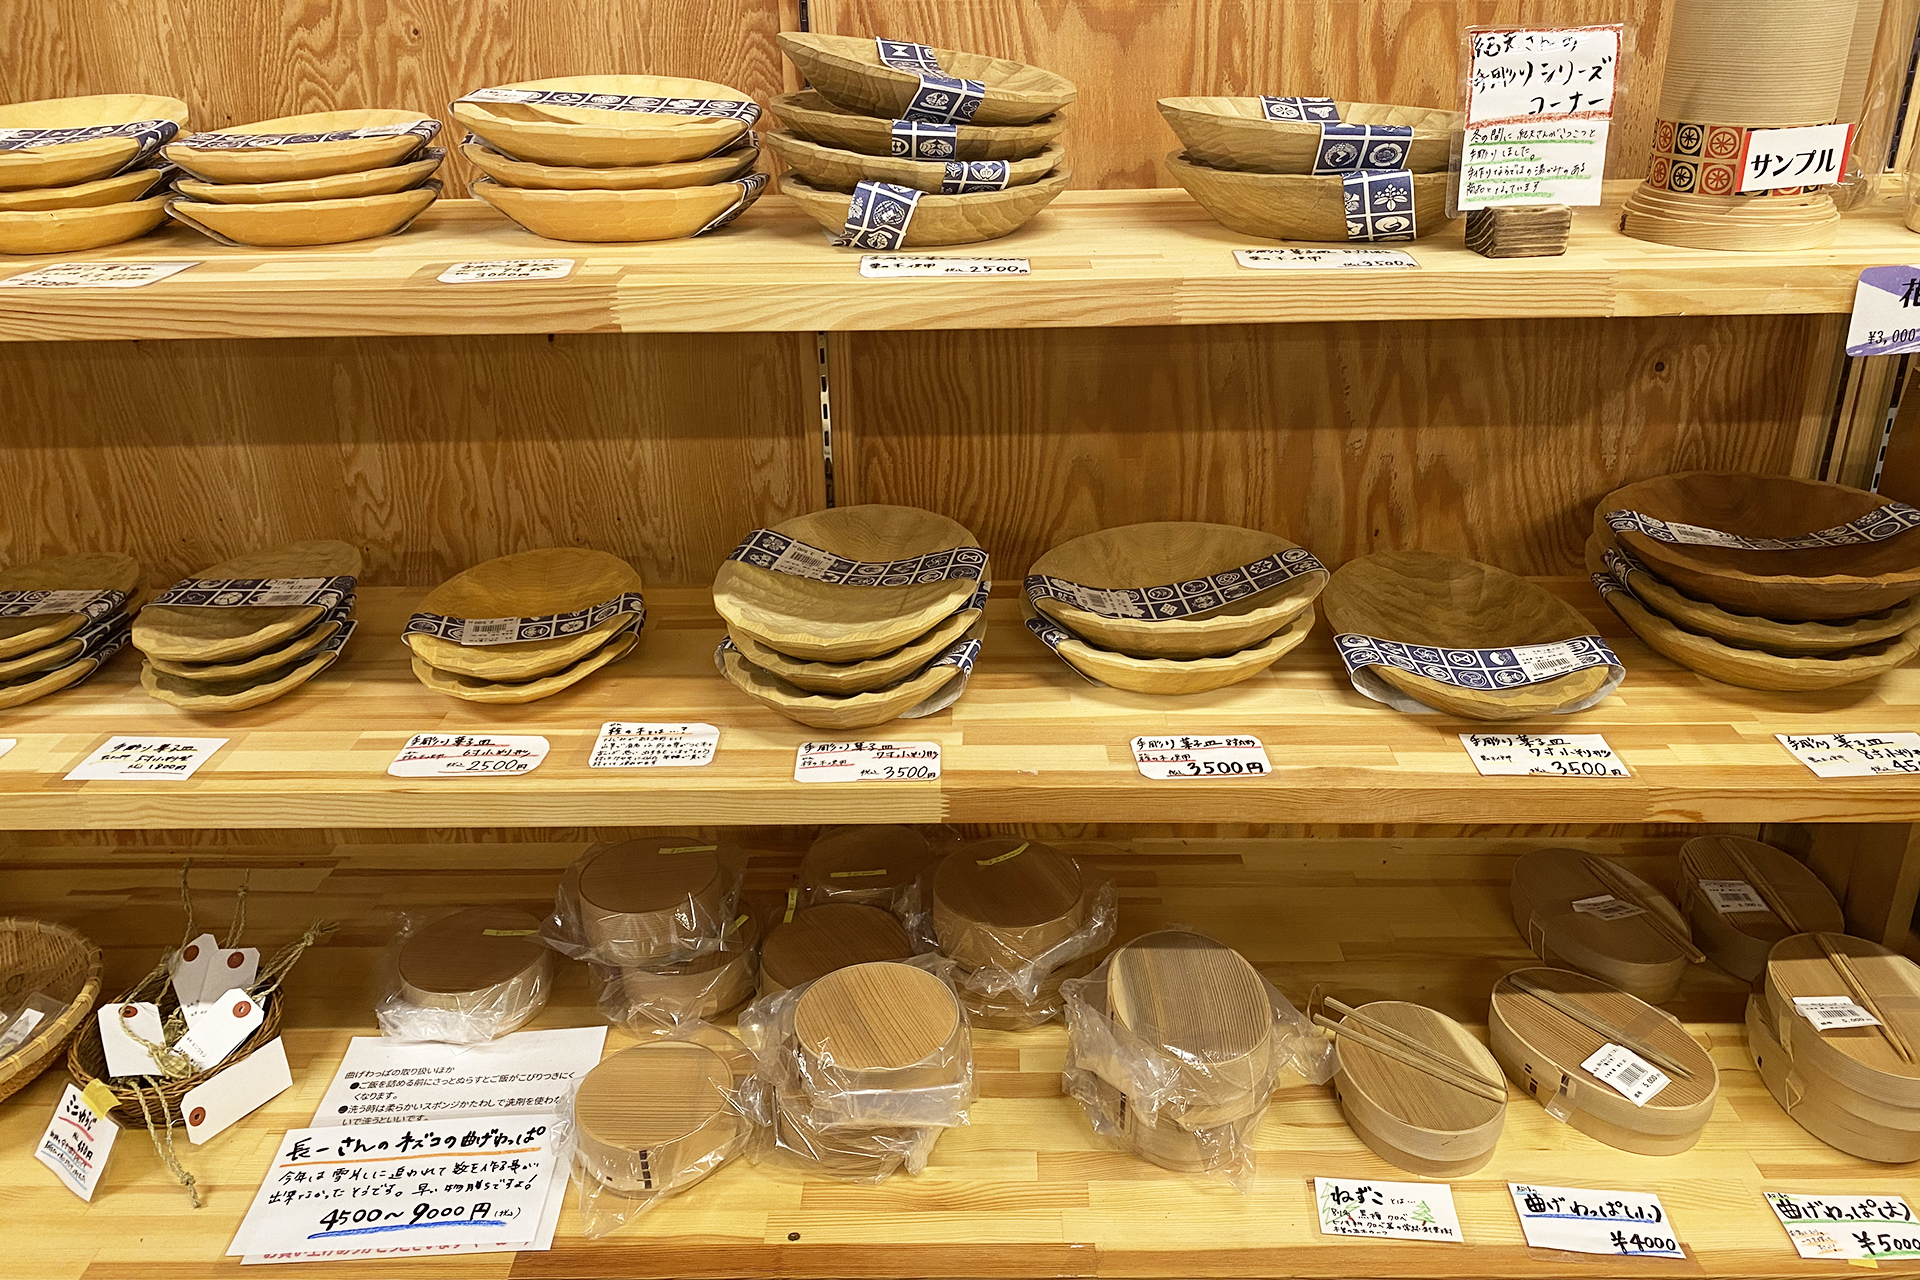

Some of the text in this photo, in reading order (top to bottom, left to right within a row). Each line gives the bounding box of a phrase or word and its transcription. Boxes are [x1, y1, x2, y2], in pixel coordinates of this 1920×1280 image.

[1529, 91, 1605, 115] コーナー
[1751, 148, 1836, 179] サンプル
[466, 759, 528, 771] 2500円
[884, 766, 936, 779] 3500円
[1187, 762, 1264, 775] 3500円
[1551, 761, 1622, 776] 3500円
[1893, 760, 1920, 772] 45
[1330, 1186, 1384, 1205] ねずこ
[1610, 1230, 1676, 1254] ¥4000
